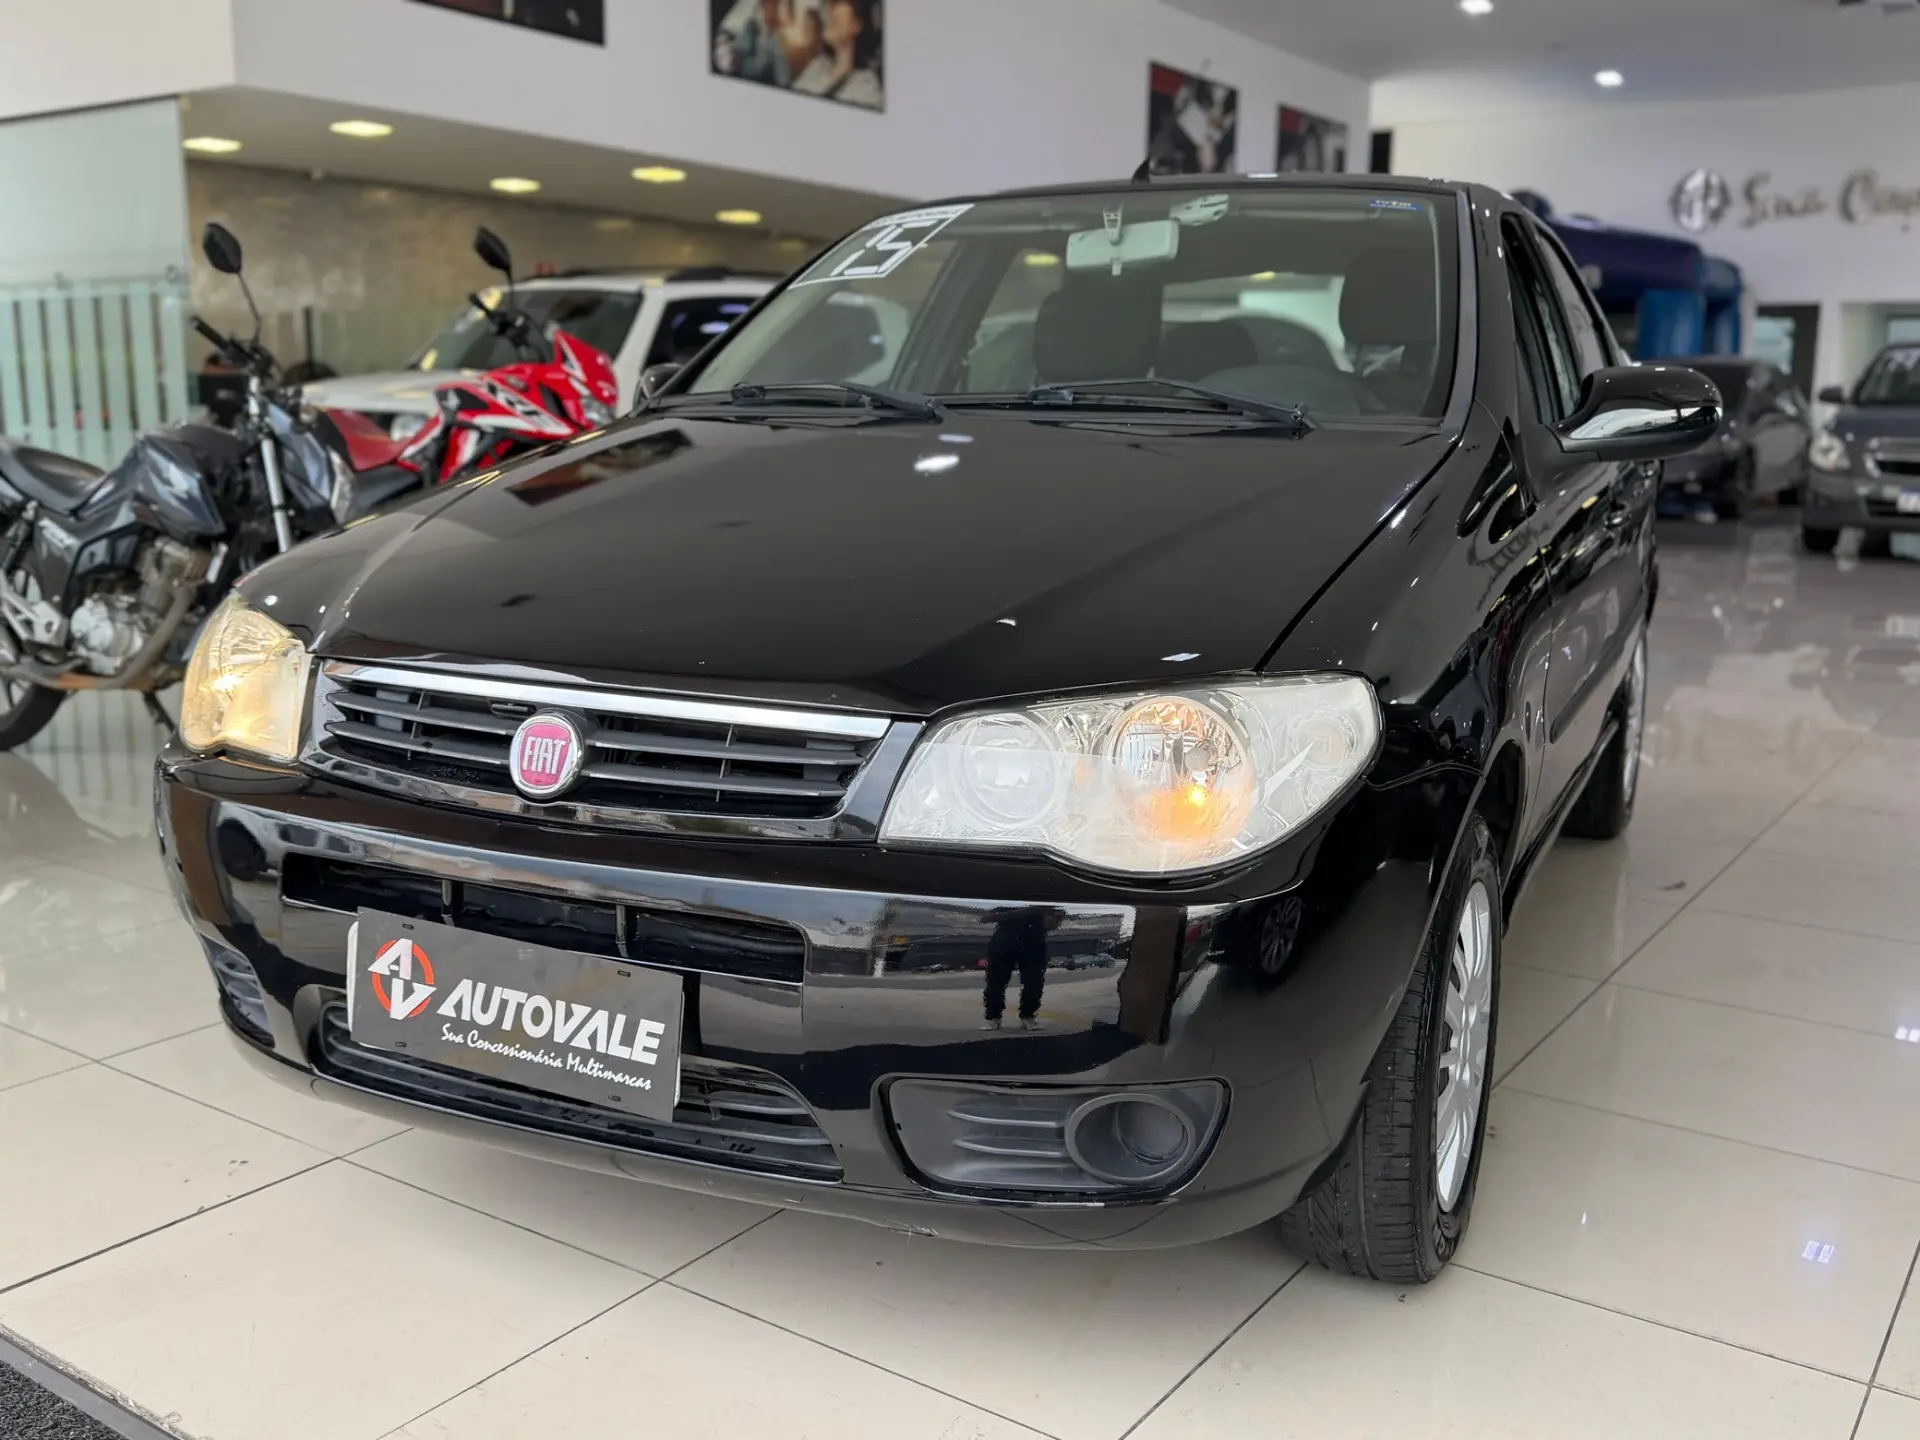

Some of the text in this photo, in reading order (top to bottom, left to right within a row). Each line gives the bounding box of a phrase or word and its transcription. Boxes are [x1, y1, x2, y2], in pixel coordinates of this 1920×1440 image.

[829, 219, 941, 277] 15
[522, 736, 567, 774] FIAT
[436, 978, 666, 1066] AUTOVALE
[441, 1023, 652, 1090] Sua Concessionária Multimarcas
